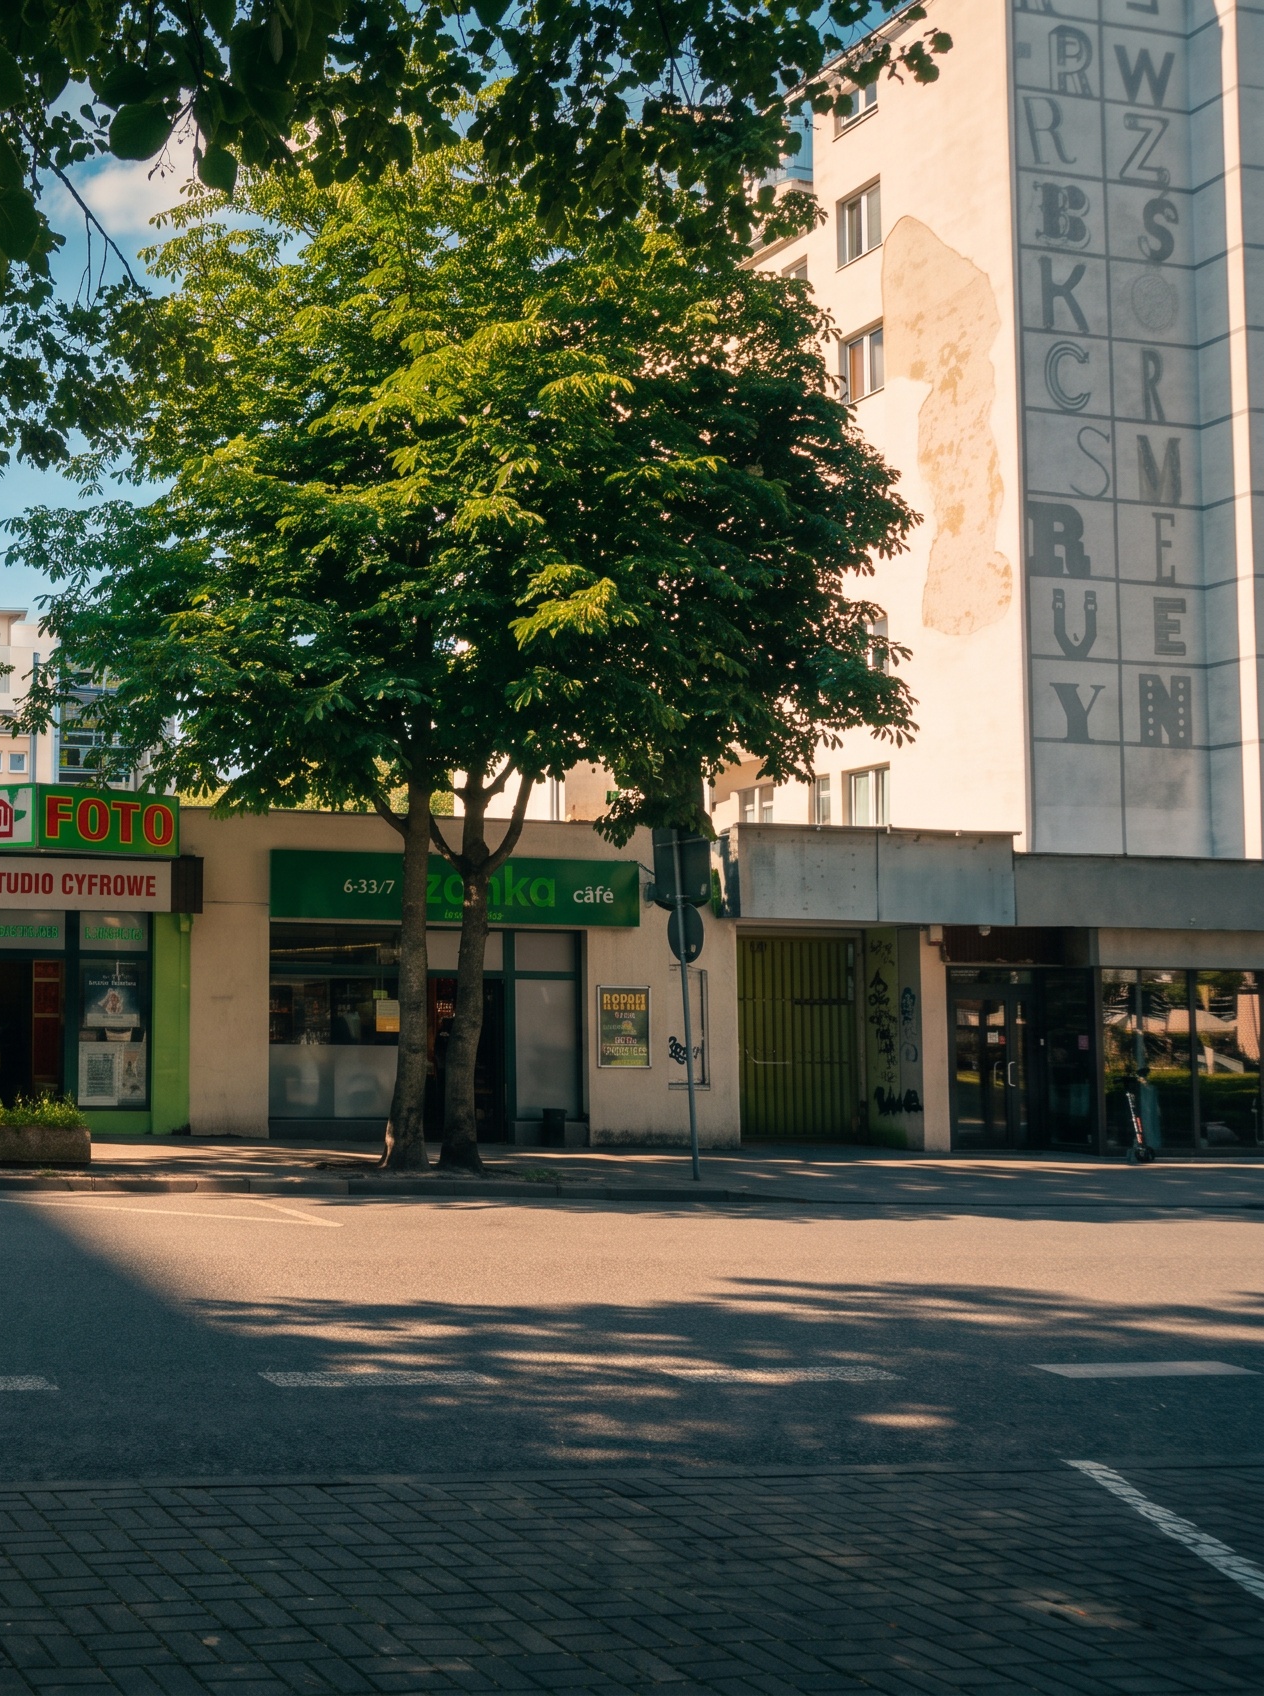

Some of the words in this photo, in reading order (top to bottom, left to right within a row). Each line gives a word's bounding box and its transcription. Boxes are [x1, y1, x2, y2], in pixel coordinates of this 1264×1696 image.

[1048, 24, 1095, 97] R
[1113, 44, 1175, 108] W
[1022, 96, 1077, 165] R
[1119, 113, 1170, 184] Z
[1033, 182, 1091, 249] B
[1138, 198, 1179, 262] S
[1038, 255, 1089, 333] K
[1044, 341, 1091, 411] C
[1141, 348, 1166, 422] R
[1069, 426, 1111, 498] S
[1026, 501, 1091, 577] R
[1152, 512, 1175, 583] E
[1052, 588, 1097, 656] U
[1153, 597, 1186, 656] E
[1049, 682, 1106, 742] Y
[1139, 673, 1193, 746] N
[44, 794, 176, 848] FOTO
[61, 873, 156, 897] CYFROWE
[343, 879, 395, 895] 6-33/7
